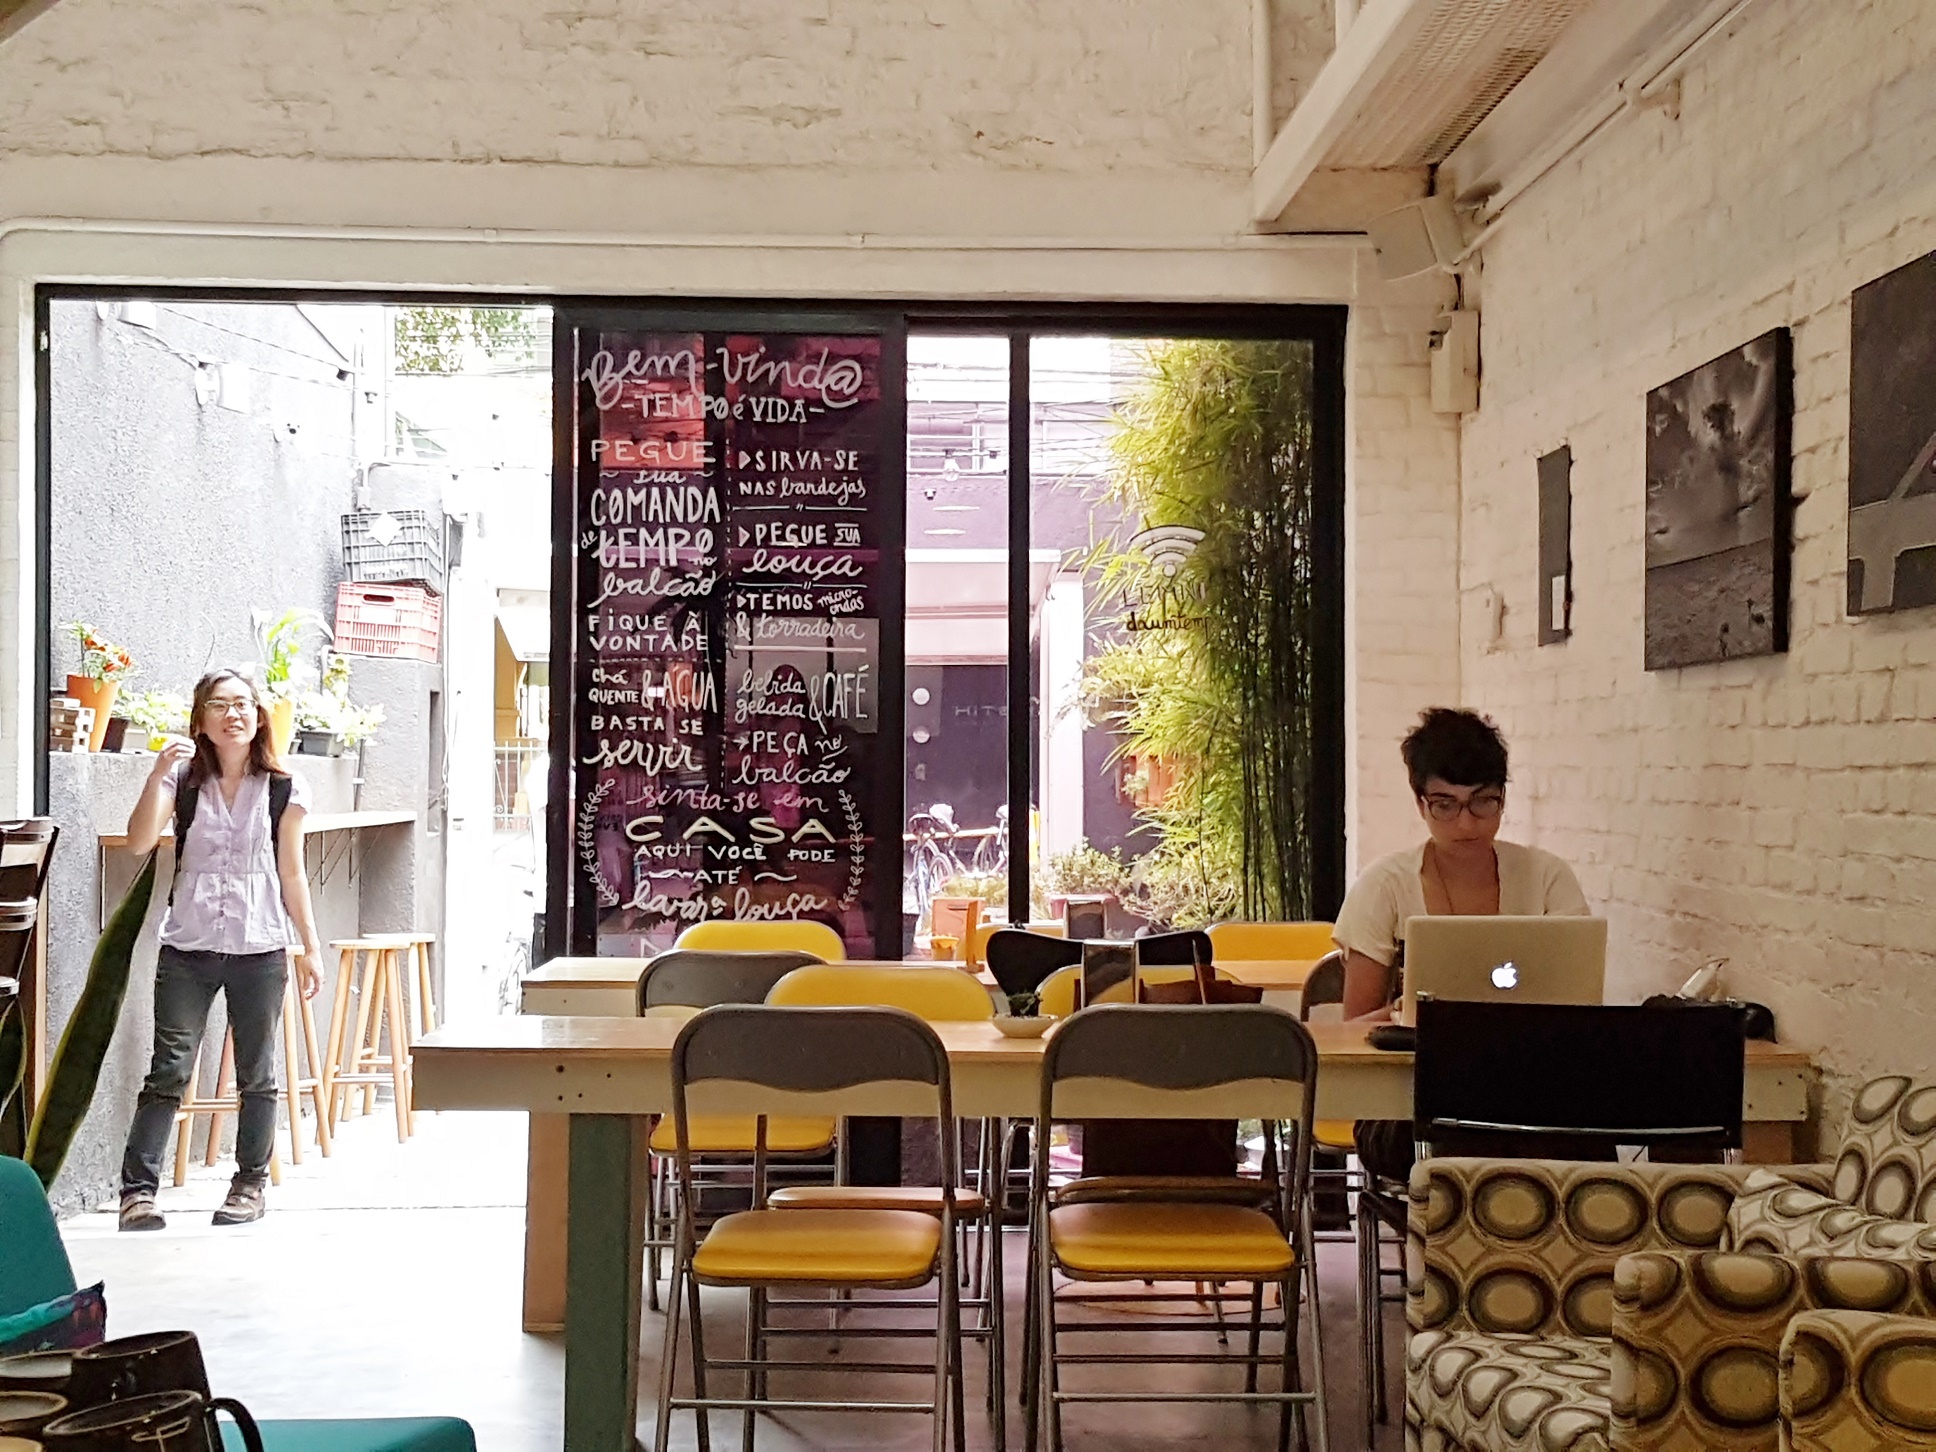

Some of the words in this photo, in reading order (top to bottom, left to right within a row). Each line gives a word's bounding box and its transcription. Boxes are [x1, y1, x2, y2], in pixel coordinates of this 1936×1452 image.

[634, 393, 730, 420] TEMPO
[751, 397, 807, 423] VIDA
[590, 440, 716, 463] PEGUE
[755, 450, 858, 473] SIRVA-SE
[590, 486, 721, 525] COMANDA
[739, 482, 776, 496] NAS
[780, 476, 867, 507] bandejas
[755, 523, 827, 546] PEGUE
[742, 549, 863, 581] louça
[587, 567, 716, 609] balcão
[748, 593, 813, 610] TEMOS
[756, 612, 865, 639] torradeira
[589, 634, 708, 652] VONTADE
[588, 688, 639, 705] QUENTE
[662, 665, 718, 713] ÁGUA
[735, 696, 805, 723] gelada
[822, 664, 870, 720] CAFÉ
[737, 668, 805, 695] bebida
[591, 715, 665, 731] BASTA
[679, 720, 704, 735] SE
[582, 737, 703, 776] servir
[752, 730, 809, 758] PEÇA
[732, 754, 852, 785] balcão
[625, 815, 837, 844] CASA
[634, 845, 692, 859] AQUI
[707, 844, 768, 861] VOCÊ
[787, 849, 836, 863] PODE
[692, 866, 742, 885] ATÉ
